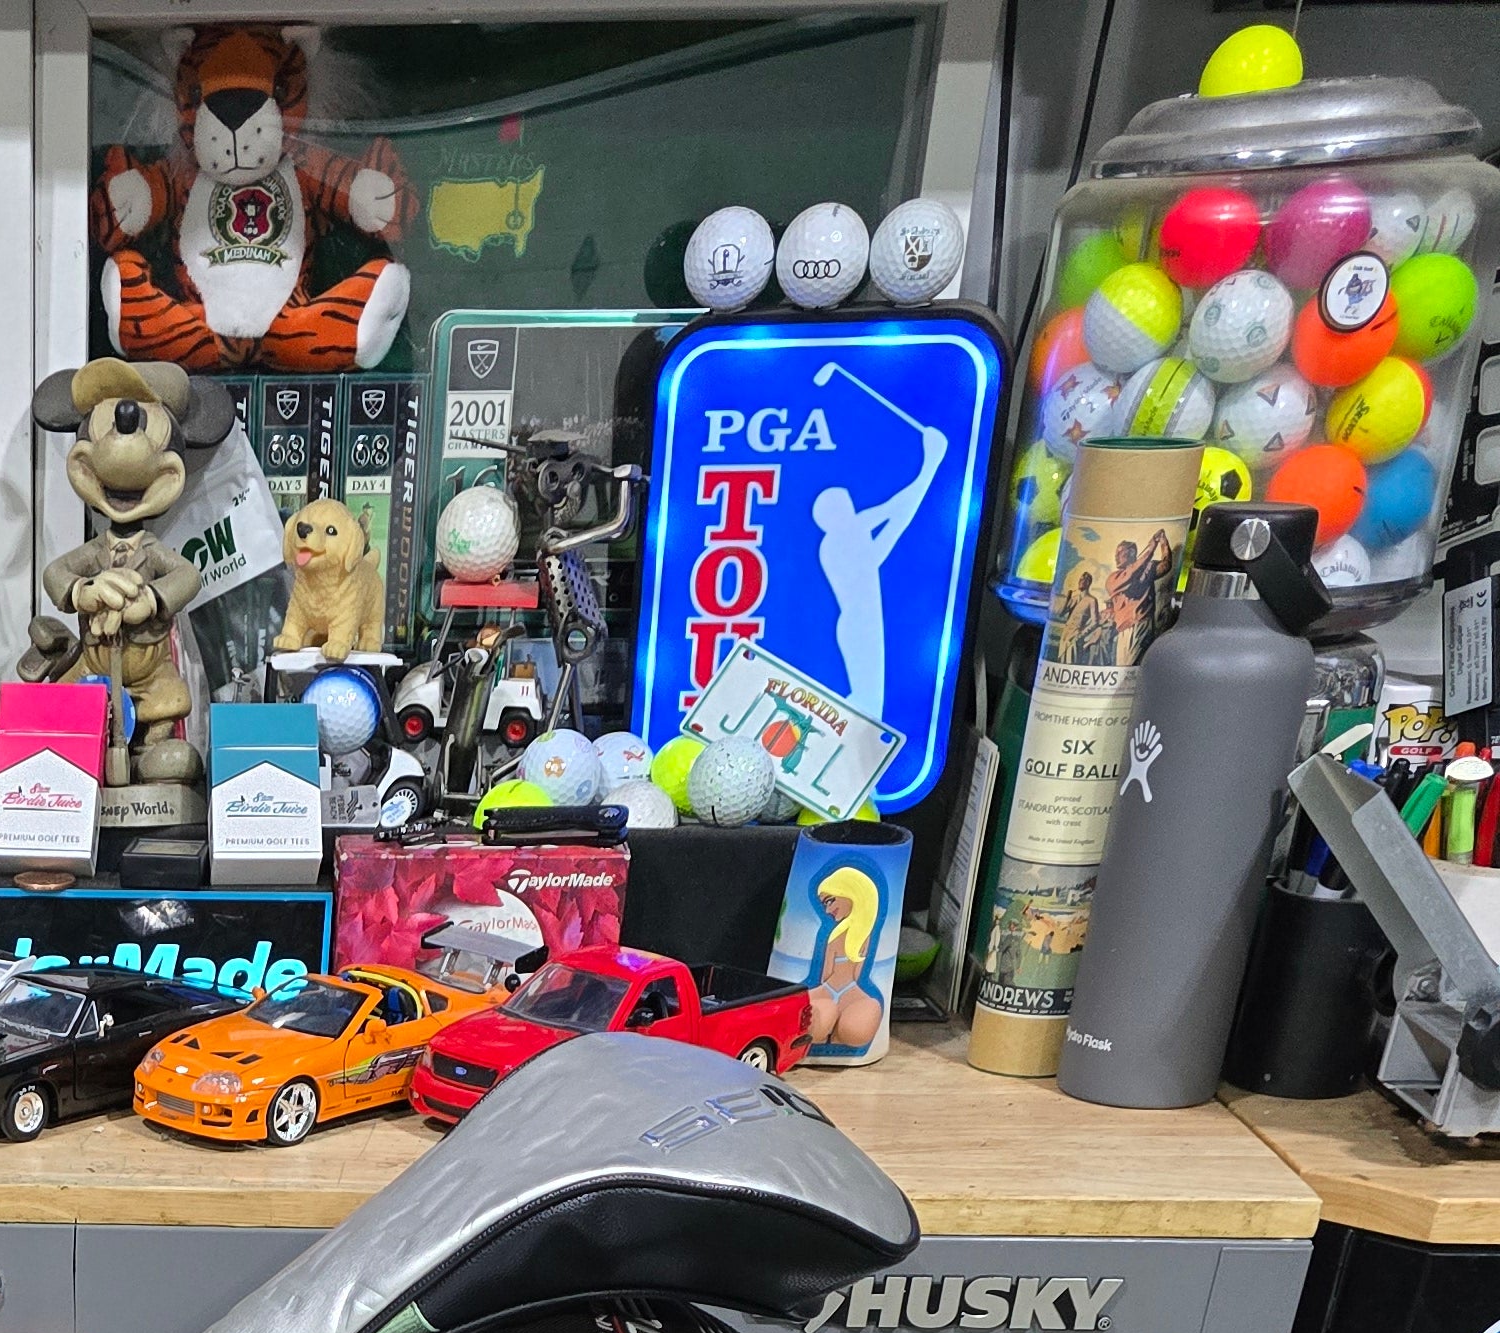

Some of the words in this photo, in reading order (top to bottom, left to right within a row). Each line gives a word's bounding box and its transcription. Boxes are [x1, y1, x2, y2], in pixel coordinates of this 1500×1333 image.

[223, 247, 272, 262] MEDINAH
[450, 399, 507, 426] 2001
[450, 427, 506, 440] MASTERS
[702, 408, 837, 453] PGA
[267, 434, 306, 468] 68
[350, 434, 390, 468] 68
[403, 396, 420, 502] TIGER
[267, 480, 293, 492] DAY
[294, 480, 302, 492] 3
[351, 480, 376, 491] DAY
[211, 555, 247, 583] World
[680, 464, 781, 712] TOU
[1042, 666, 1119, 686] ANDREWS
[766, 676, 849, 738] FLORIDA
[1052, 714, 1070, 725] THE
[1071, 716, 1103, 727] HOME
[1105, 717, 1119, 727] OF
[1061, 739, 1096, 755] SIX
[1400, 747, 1433, 755] GOLF
[1024, 758, 1068, 777] GOLF
[1073, 764, 1119, 779] BALL
[2, 791, 47, 808] Birdie
[47, 793, 83, 809] Juice
[130, 800, 169, 816] World
[225, 799, 270, 815] Birdie
[271, 800, 308, 815] Juice
[329, 797, 337, 819] BEACH
[337, 795, 346, 821] PEBBLE
[1071, 806, 1113, 816] SCOTLA
[37, 834, 59, 843] GOLF
[61, 835, 80, 844] TEES
[226, 837, 263, 846] PREMIUM
[265, 837, 288, 846] GOLF
[290, 837, 310, 846] TEES
[508, 869, 613, 894] TaylorMade
[980, 982, 1055, 1009] ANDREWS
[1082, 1034, 1113, 1052] Flask
[845, 1276, 1124, 1331] HUSKY
